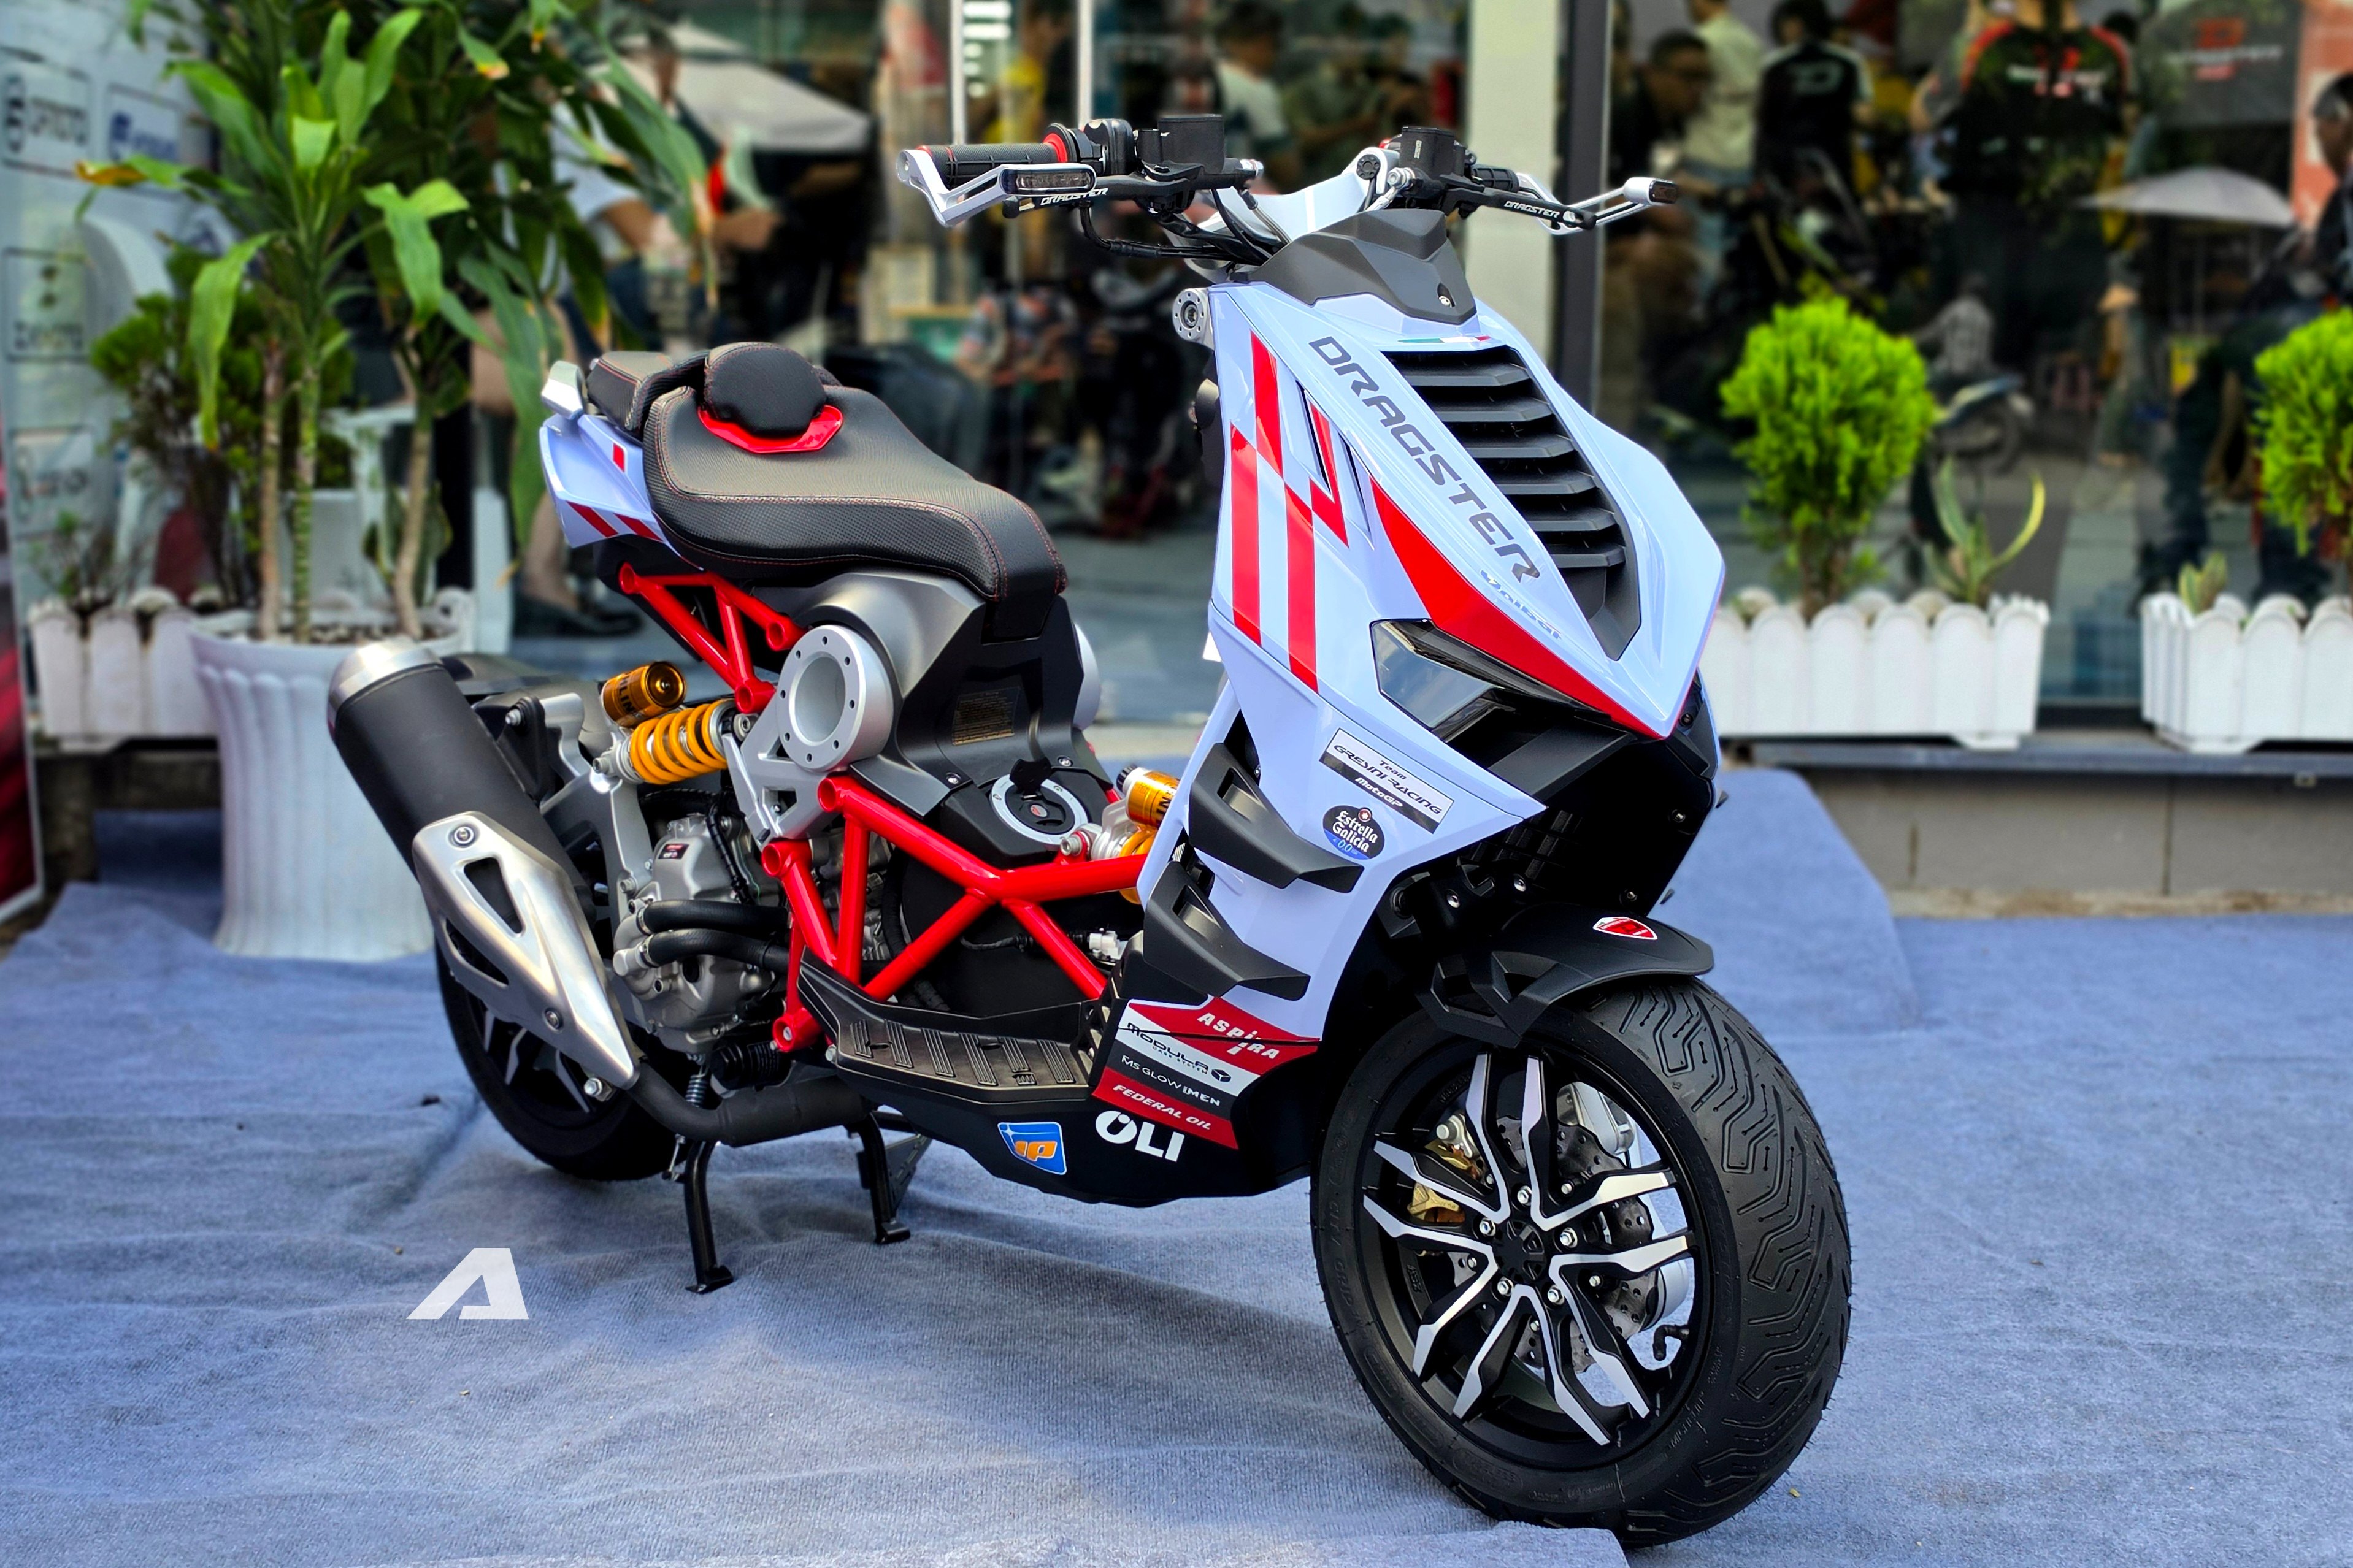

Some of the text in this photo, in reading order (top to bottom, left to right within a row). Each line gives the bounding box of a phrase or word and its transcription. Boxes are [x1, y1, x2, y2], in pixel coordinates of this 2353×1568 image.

[1503, 201, 1560, 218] DRAGSTER
[1308, 336, 1541, 583] DRAGSTER
[1334, 745, 1443, 815] GRESINI RACING
[1380, 760, 1407, 780] Team
[1354, 777, 1403, 808] MotoGP
[1332, 821, 1370, 853] Galicia
[1335, 810, 1378, 844] Estrella
[1121, 1054, 1141, 1071] MS
[1142, 1066, 1182, 1090] GLOW
[1112, 1084, 1212, 1130] FEDERAL OIL
